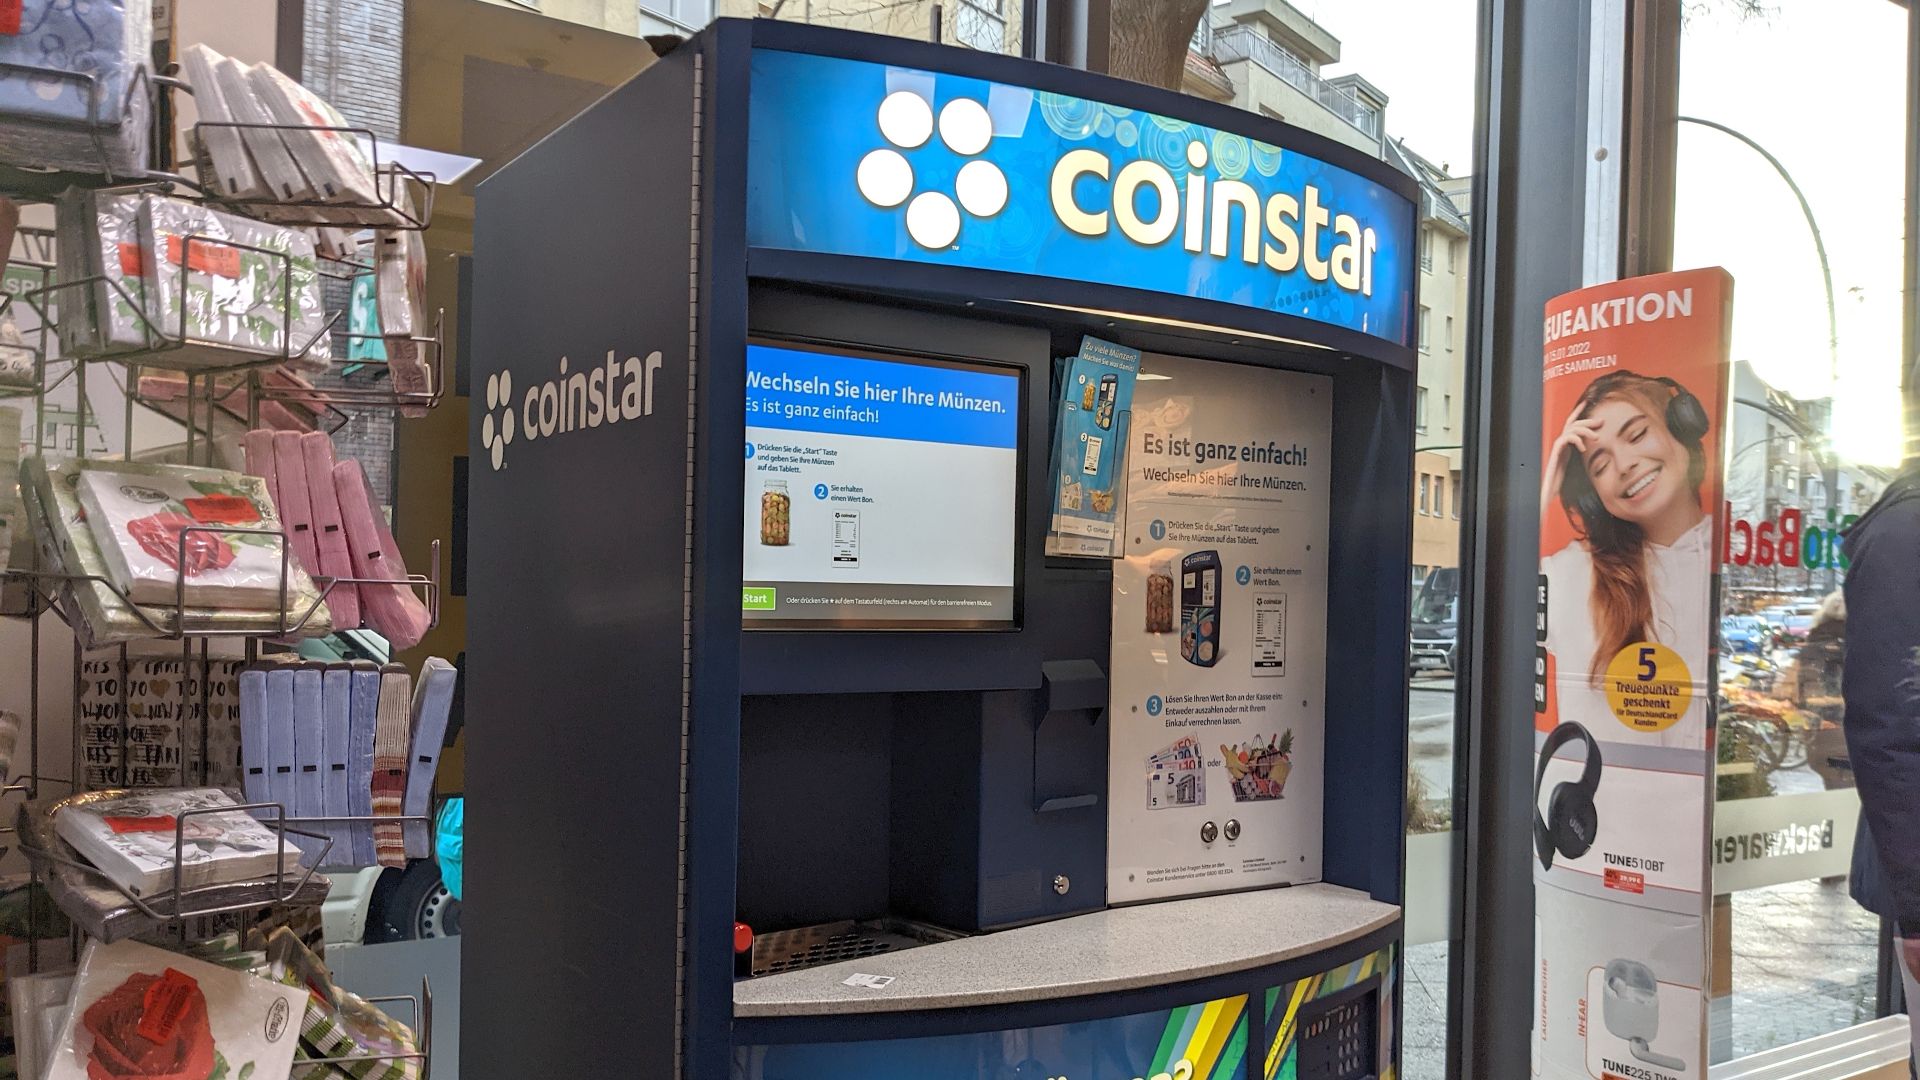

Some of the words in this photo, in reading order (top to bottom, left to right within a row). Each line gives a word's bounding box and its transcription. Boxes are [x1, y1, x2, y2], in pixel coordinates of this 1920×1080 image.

[1050, 140, 1377, 298] coinstar
[1544, 287, 1693, 347] EUEAKTION
[1085, 342, 1094, 351] Zu
[1094, 345, 1109, 356] viele
[1108, 348, 1137, 363] Münzen?
[1565, 354, 1617, 375] SAMMELN
[523, 349, 663, 441] coinstar
[746, 371, 830, 396] Wechseln
[834, 380, 860, 400] Sie
[864, 381, 899, 402] hier
[902, 388, 935, 408] Ihre
[938, 392, 1006, 414] Münzen.
[763, 399, 781, 414] ist
[785, 404, 820, 419] ganz
[823, 406, 880, 424] einfach!
[757, 443, 783, 452] Drücken
[792, 446, 802, 454] die
[823, 448, 838, 456] Taste
[1143, 433, 1164, 455] Es
[1168, 433, 1191, 457] ist
[1195, 441, 1238, 464] ganz
[1241, 440, 1308, 467] einfach!
[757, 454, 770, 462] und
[770, 455, 789, 463] geben
[799, 456, 811, 464] Ihre
[811, 457, 835, 466] Münzen
[767, 464, 779, 472] das
[779, 465, 802, 473] Tablett.
[1143, 467, 1197, 484] Wechseln
[1199, 471, 1215, 485] Sie
[1217, 472, 1239, 487] hier
[1240, 474, 1261, 488] Ihre
[1262, 476, 1307, 492] Münzen.
[840, 485, 864, 493] erhalten
[847, 495, 862, 503] Wert
[862, 496, 875, 504] Bon.
[1168, 520, 1194, 530] Drücken
[1194, 521, 1204, 530] Sie
[1204, 522, 1214, 531] die
[1234, 524, 1250, 533] Taste
[1250, 525, 1261, 533] und
[1261, 526, 1280, 535] geben
[1168, 532, 1178, 541] Sie
[1178, 533, 1191, 542] Ihre
[1191, 533, 1215, 543] Münzen
[1215, 534, 1226, 543] auf
[1226, 535, 1237, 544] das
[1237, 536, 1259, 545] Tablett.
[1190, 553, 1212, 564] coinstar
[1253, 566, 1262, 575] Sie
[1262, 566, 1286, 576] erhalten
[1286, 567, 1302, 576] einen
[1253, 578, 1267, 586] Wert
[1268, 578, 1281, 587] Bon.
[744, 593, 767, 604] Start
[1637, 647, 1657, 682] 5
[95, 677, 148, 698] TOYO
[1615, 681, 1680, 698] Treuepunkte
[1165, 694, 1183, 704] Lösen
[1183, 694, 1193, 703] Sie
[1193, 693, 1209, 703] Ihren
[1210, 693, 1225, 702] Wert
[1225, 693, 1237, 702] Bon
[1245, 693, 1255, 701] der
[1255, 692, 1272, 701] Kasse
[1623, 696, 1671, 710] geschenkt
[1165, 706, 1194, 716] Entweder
[1194, 705, 1224, 714] auszahlen
[1224, 705, 1238, 713] oder
[1238, 704, 1249, 713] mit
[1249, 704, 1266, 713] Ihrem
[1616, 708, 1625, 716] für
[1625, 709, 1678, 720] DeutschlandCard
[1165, 718, 1188, 728] Einkauf
[1188, 717, 1222, 727] verrechnen
[1222, 717, 1242, 725] lassen.
[1634, 718, 1658, 727] Kunden
[1207, 758, 1221, 767] oder
[1167, 772, 1175, 785] 5
[1152, 797, 1158, 807] 5
[1603, 852, 1665, 873] TUNE510BT
[1578, 997, 1587, 1037] IN-EAR
[1602, 1058, 1652, 1080] TUNE225
